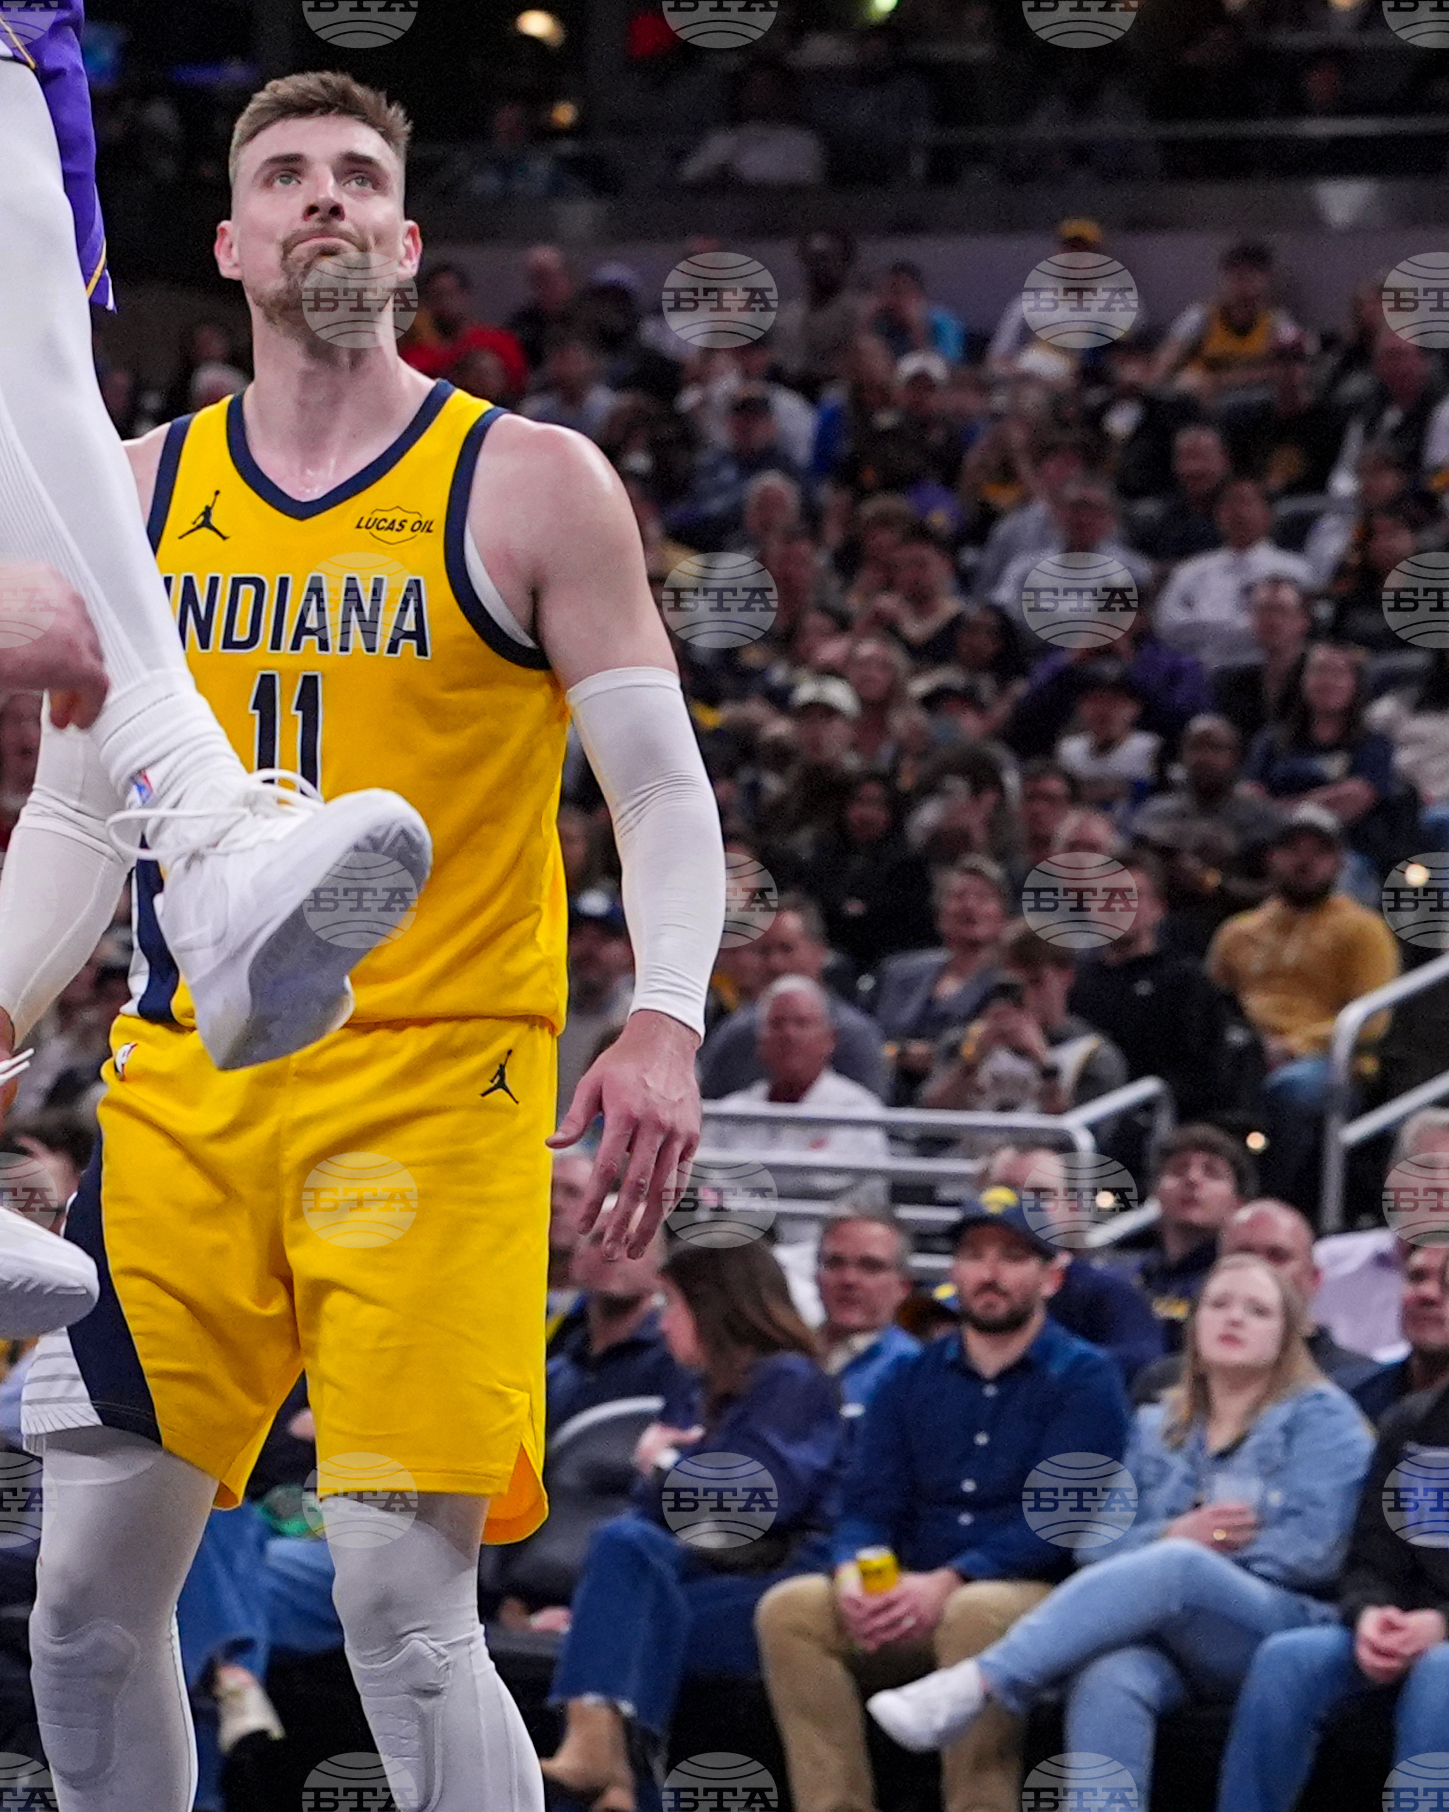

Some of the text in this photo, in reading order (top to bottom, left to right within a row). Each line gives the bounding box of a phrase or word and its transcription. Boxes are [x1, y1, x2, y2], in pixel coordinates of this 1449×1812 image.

[355, 515, 434, 534] LUCAS OIL
[248, 670, 323, 800] 11
